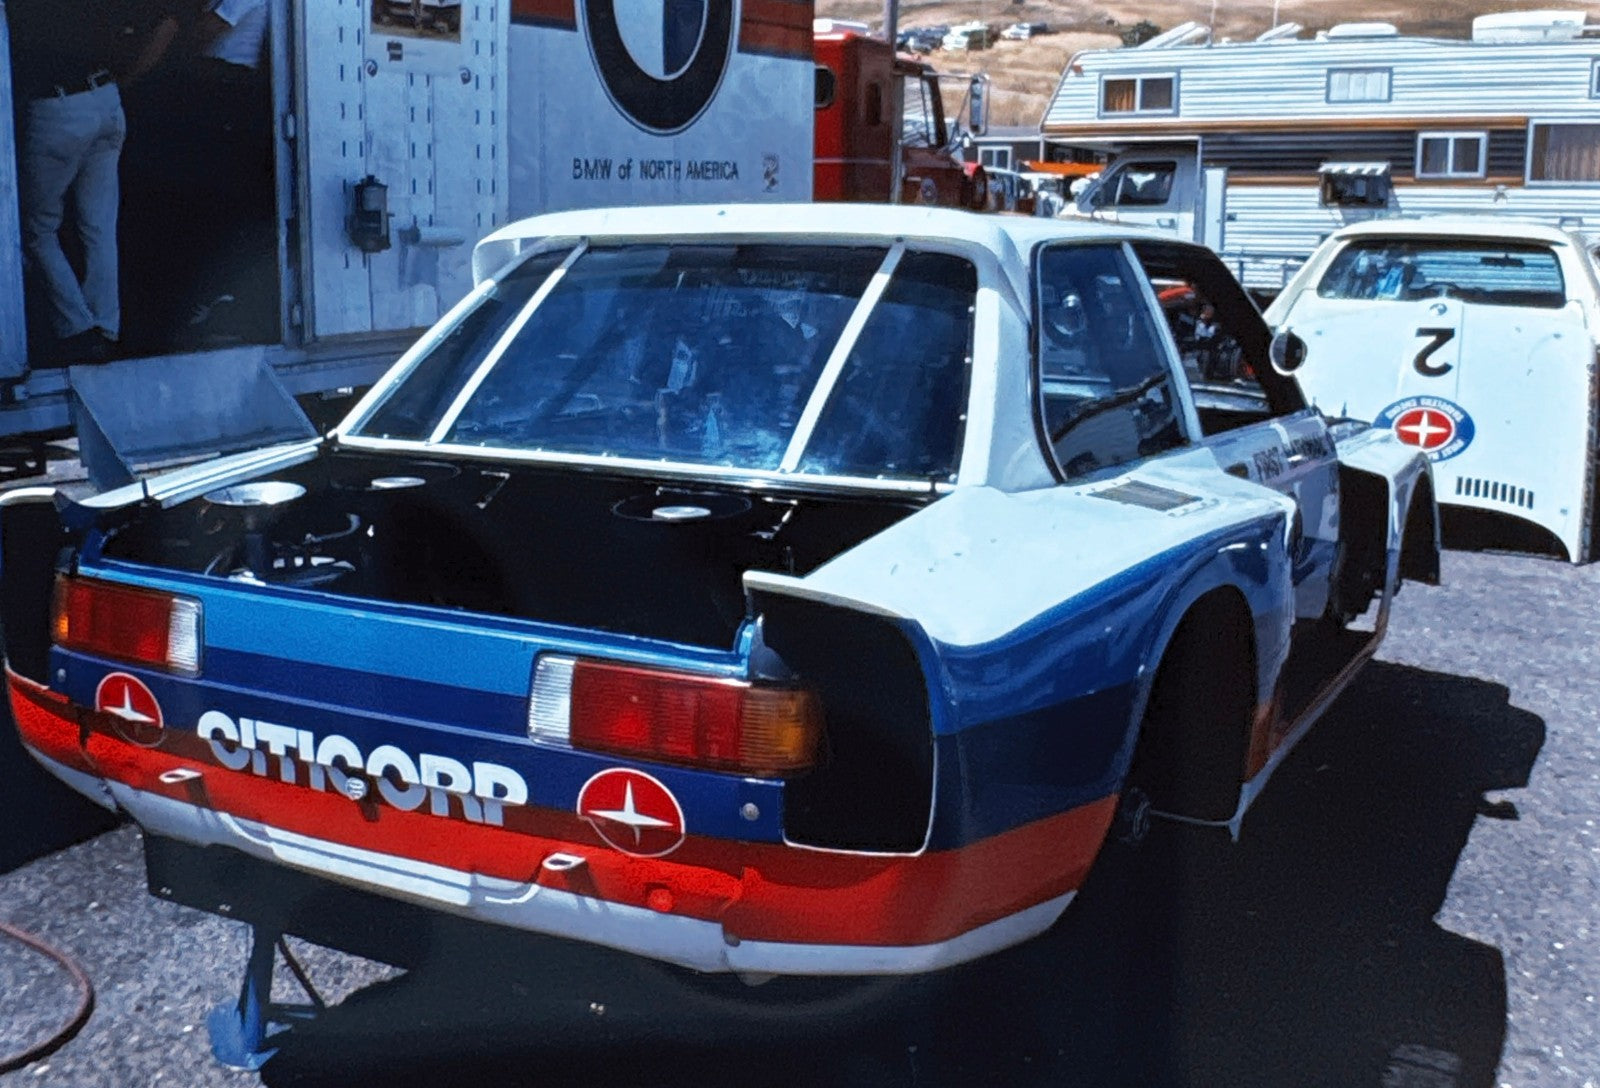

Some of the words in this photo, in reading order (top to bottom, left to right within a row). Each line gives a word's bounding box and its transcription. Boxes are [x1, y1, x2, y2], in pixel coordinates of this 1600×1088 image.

[572, 158, 612, 181] BMW
[618, 157, 632, 181] of
[640, 160, 681, 181] NORTH
[686, 160, 740, 181] AMERICA
[1413, 327, 1455, 377] 2
[197, 710, 528, 827] CITICORP
